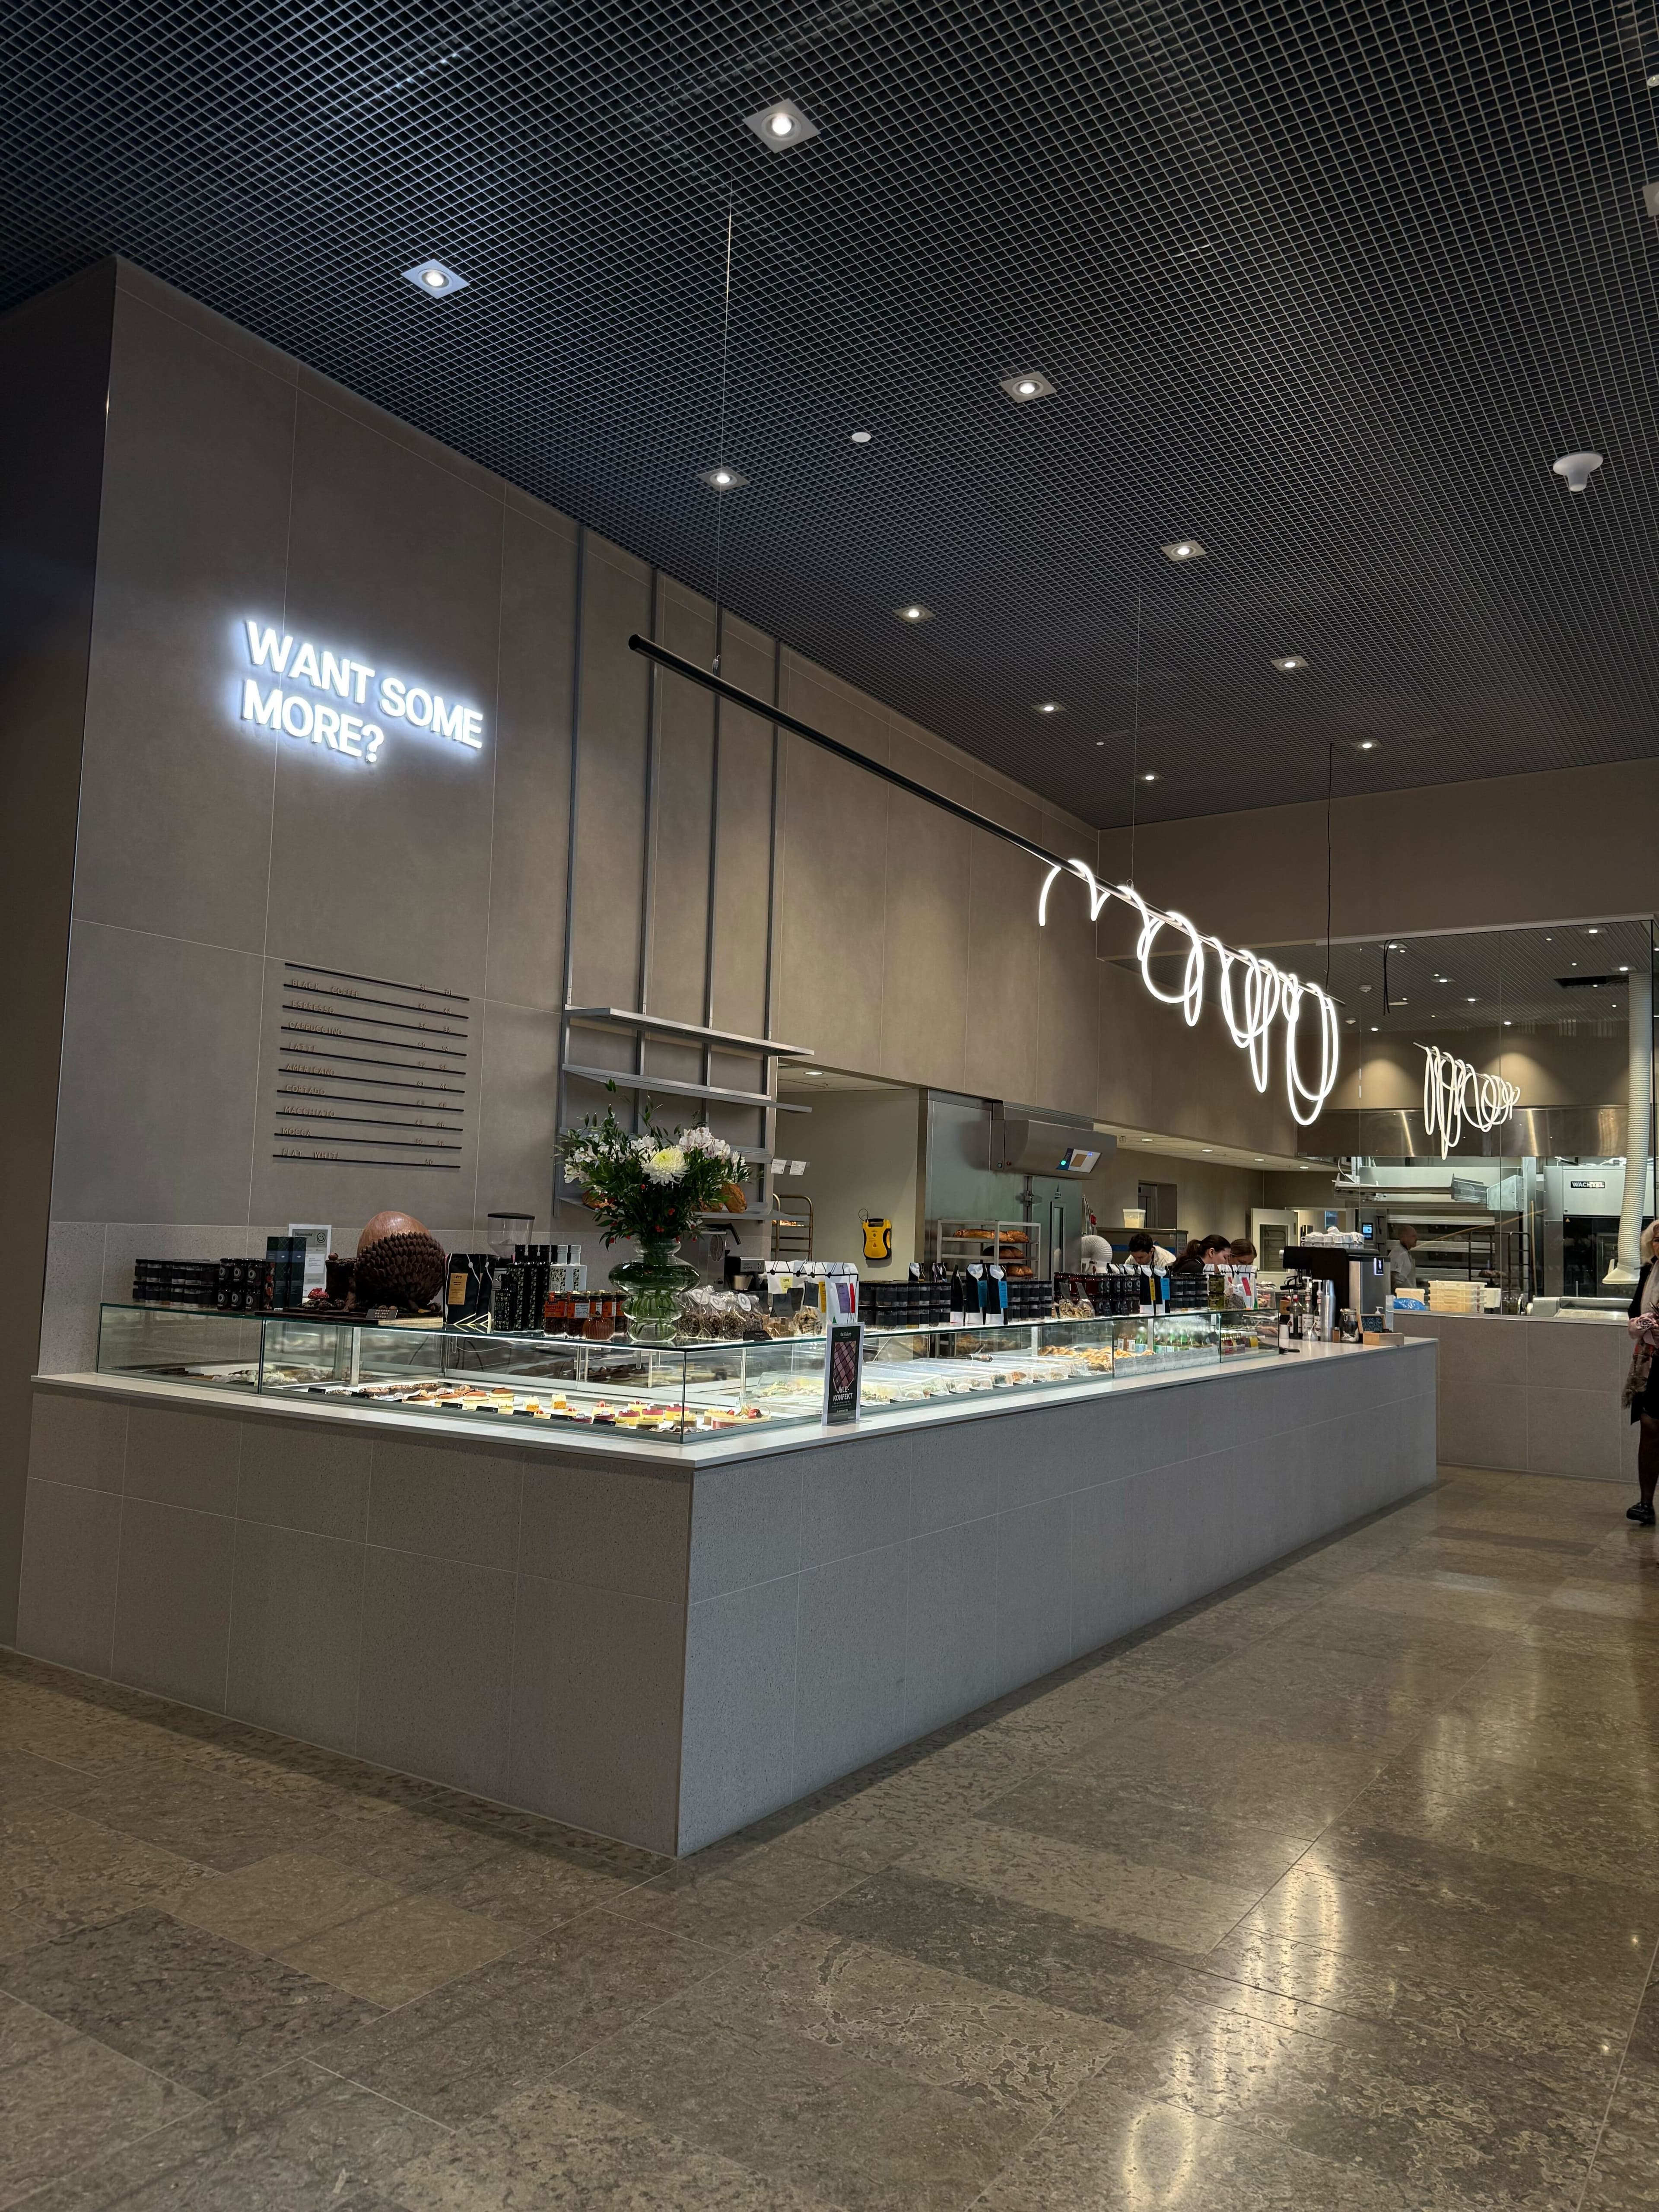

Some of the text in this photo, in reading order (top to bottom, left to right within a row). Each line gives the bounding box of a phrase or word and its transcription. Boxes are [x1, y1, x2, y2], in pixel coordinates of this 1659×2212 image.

[245, 620, 483, 749] WANT SOME
[242, 679, 384, 763] MORE?
[292, 979, 319, 990] BLACK
[331, 986, 359, 997] COFFEE
[292, 1001, 335, 1014] ESPRESSO
[289, 1022, 343, 1035] CAPPUCCINO
[289, 1042, 318, 1053] LATTE
[286, 1064, 335, 1076] AMERICANO
[286, 1085, 325, 1095] CORTADO
[284, 1106, 335, 1117] MACCHIATO
[282, 1127, 311, 1137] MOCCA
[282, 1148, 303, 1157] FLAT
[314, 1151, 340, 1160] WHITE
[833, 1392, 853, 1402] KONFEKT
